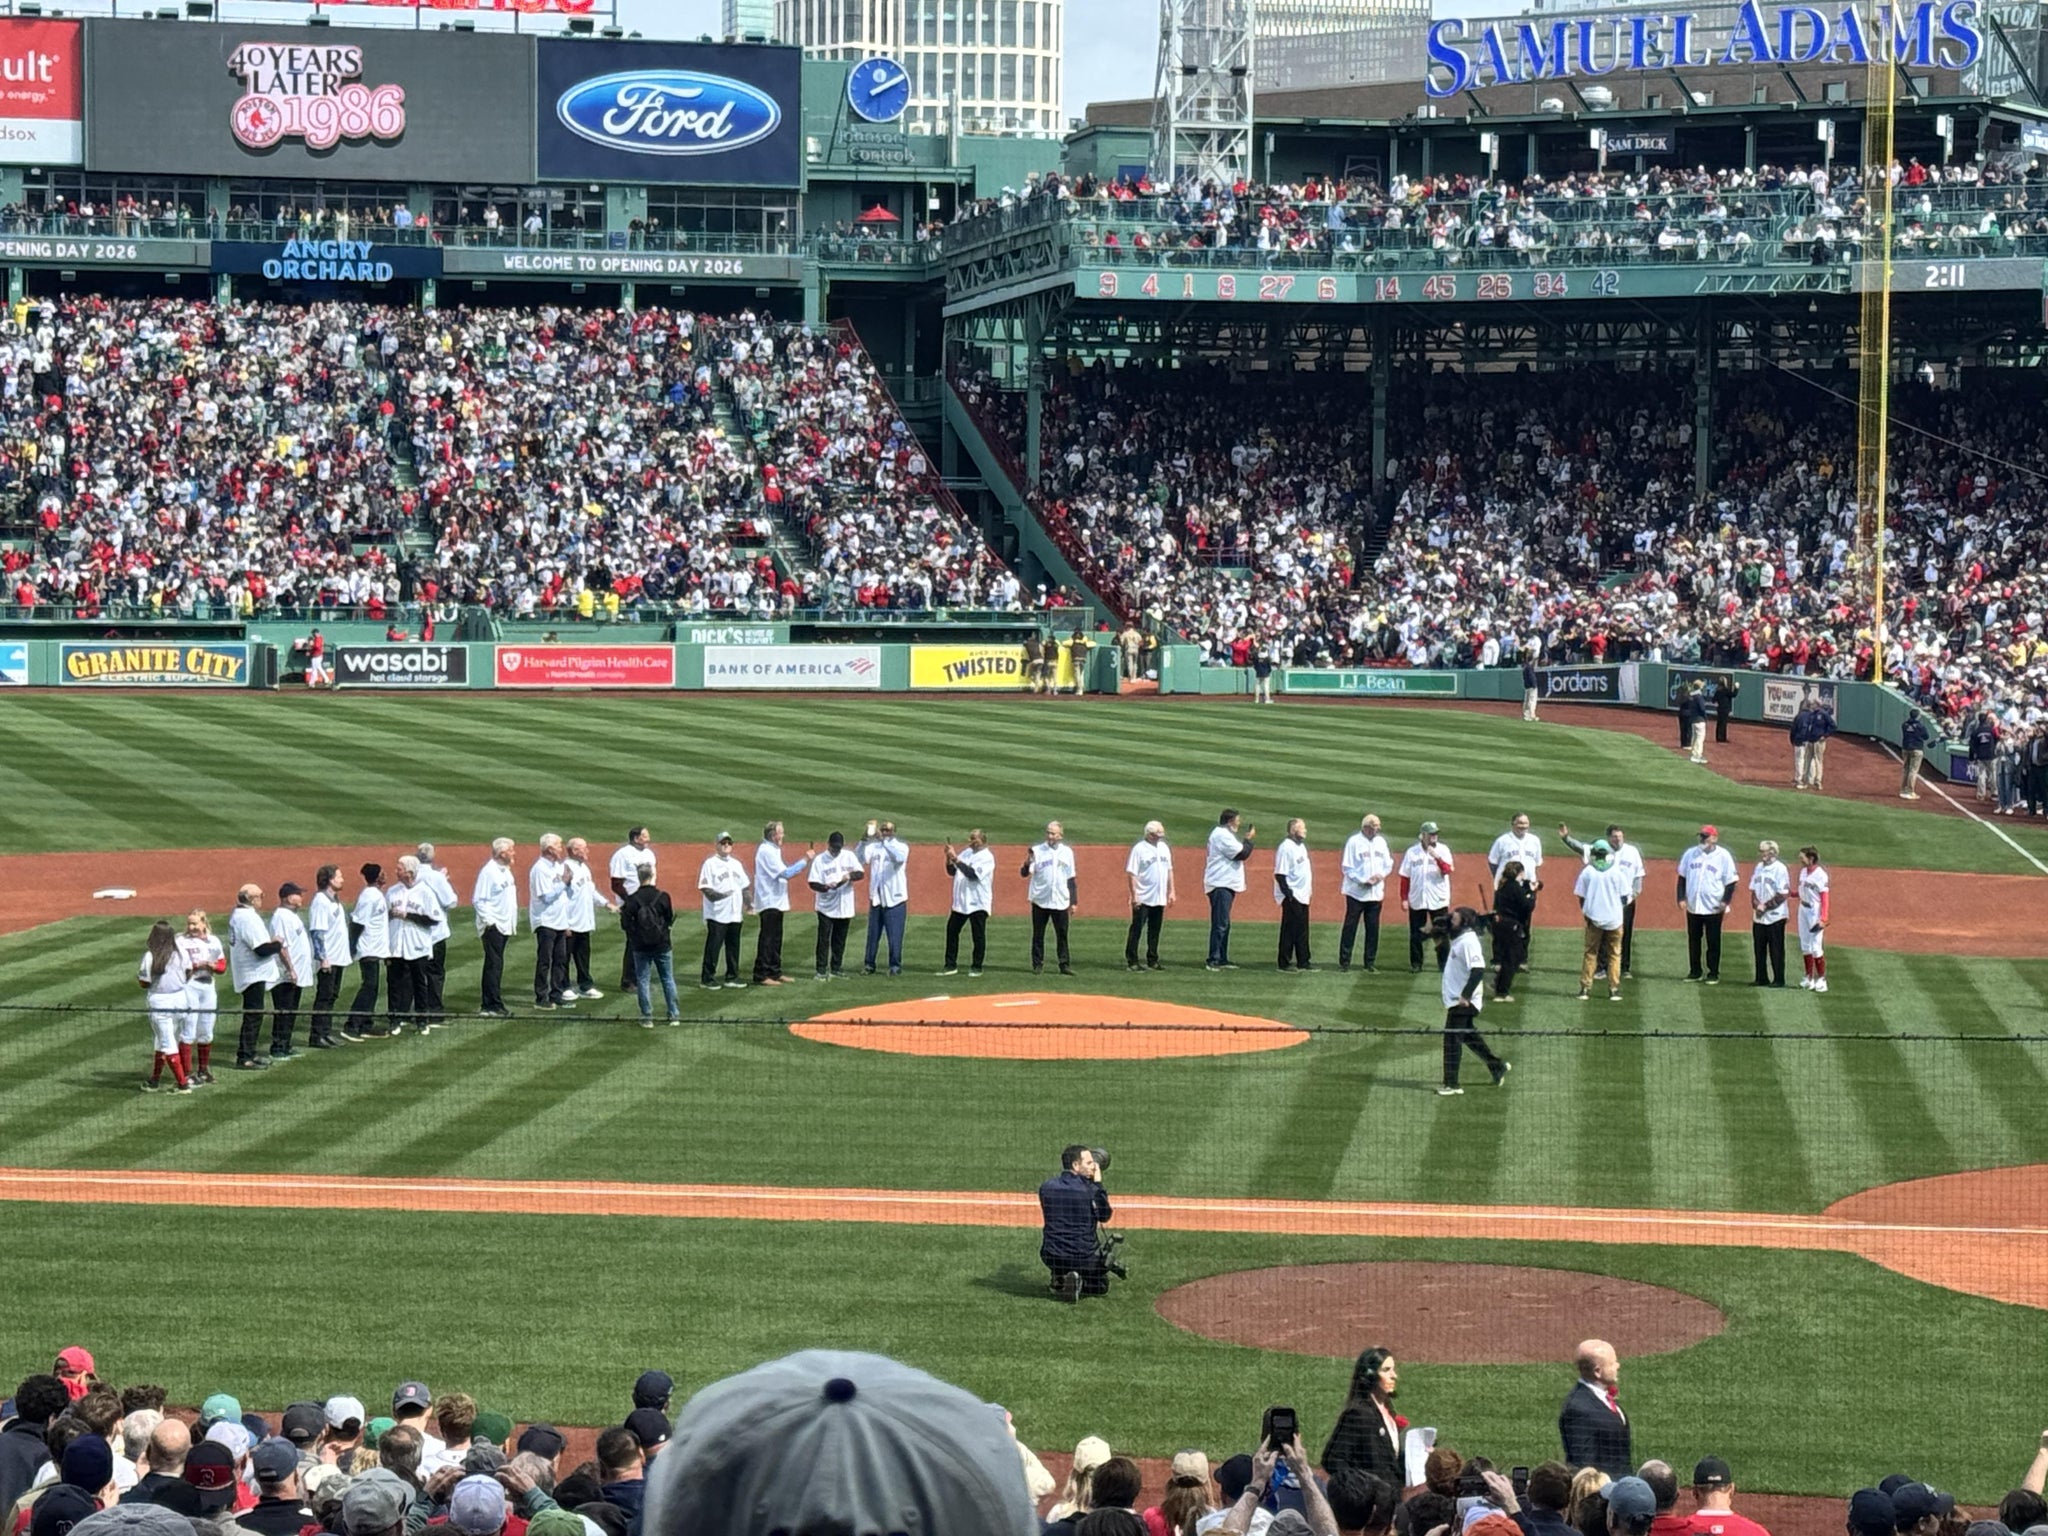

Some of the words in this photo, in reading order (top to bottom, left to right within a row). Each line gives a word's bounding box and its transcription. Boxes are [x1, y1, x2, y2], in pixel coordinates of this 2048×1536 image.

[1425, 13, 1712, 98] SAMUEL
[1718, 0, 1984, 71] ADAMS
[0, 50, 53, 82] ult
[232, 47, 265, 73] 40
[268, 47, 360, 75] YEARS
[253, 71, 339, 96] LATER
[284, 85, 405, 146] 1986
[603, 82, 737, 139] Ford
[1607, 138, 1632, 152] SAM
[1635, 137, 1668, 151] DECK
[56, 243, 90, 258] DAY
[95, 244, 138, 259] 2026
[282, 238, 373, 260] ANGRY
[262, 259, 394, 282] ORCHARD
[503, 255, 573, 270] WELCOME
[577, 256, 596, 271] TO
[601, 257, 664, 273] OPENING
[668, 258, 700, 273] DAY
[704, 259, 743, 274] 2026
[1925, 264, 1965, 287] 2:11
[1100, 272, 1118, 297] 9
[1141, 273, 1160, 297] 4
[1183, 273, 1194, 298] 1
[1217, 274, 1236, 300] 8
[1259, 275, 1295, 300] 27
[1317, 276, 1337, 300] 6
[1375, 276, 1401, 301] 14
[1422, 275, 1457, 300] 45
[1477, 273, 1512, 300] 26
[1533, 272, 1568, 298] 34
[1590, 270, 1620, 296] 42
[691, 627, 743, 645] DICK'S
[67, 649, 181, 679] GRANITE
[186, 648, 242, 680] CITY
[343, 647, 448, 672] wasabi
[524, 657, 567, 668] Harvard
[568, 657, 606, 671] Pilgrim
[607, 657, 643, 669] Health
[644, 657, 668, 669] Care
[708, 664, 749, 675] BANK
[753, 664, 772, 675] OF
[775, 664, 842, 675] AMERICA
[942, 656, 1017, 682] TWISTED
[100, 673, 162, 683] ELECTRIC
[166, 673, 209, 683] SUPPLY
[369, 673, 386, 682] hot
[387, 673, 413, 682] cloud
[414, 673, 448, 684] storage
